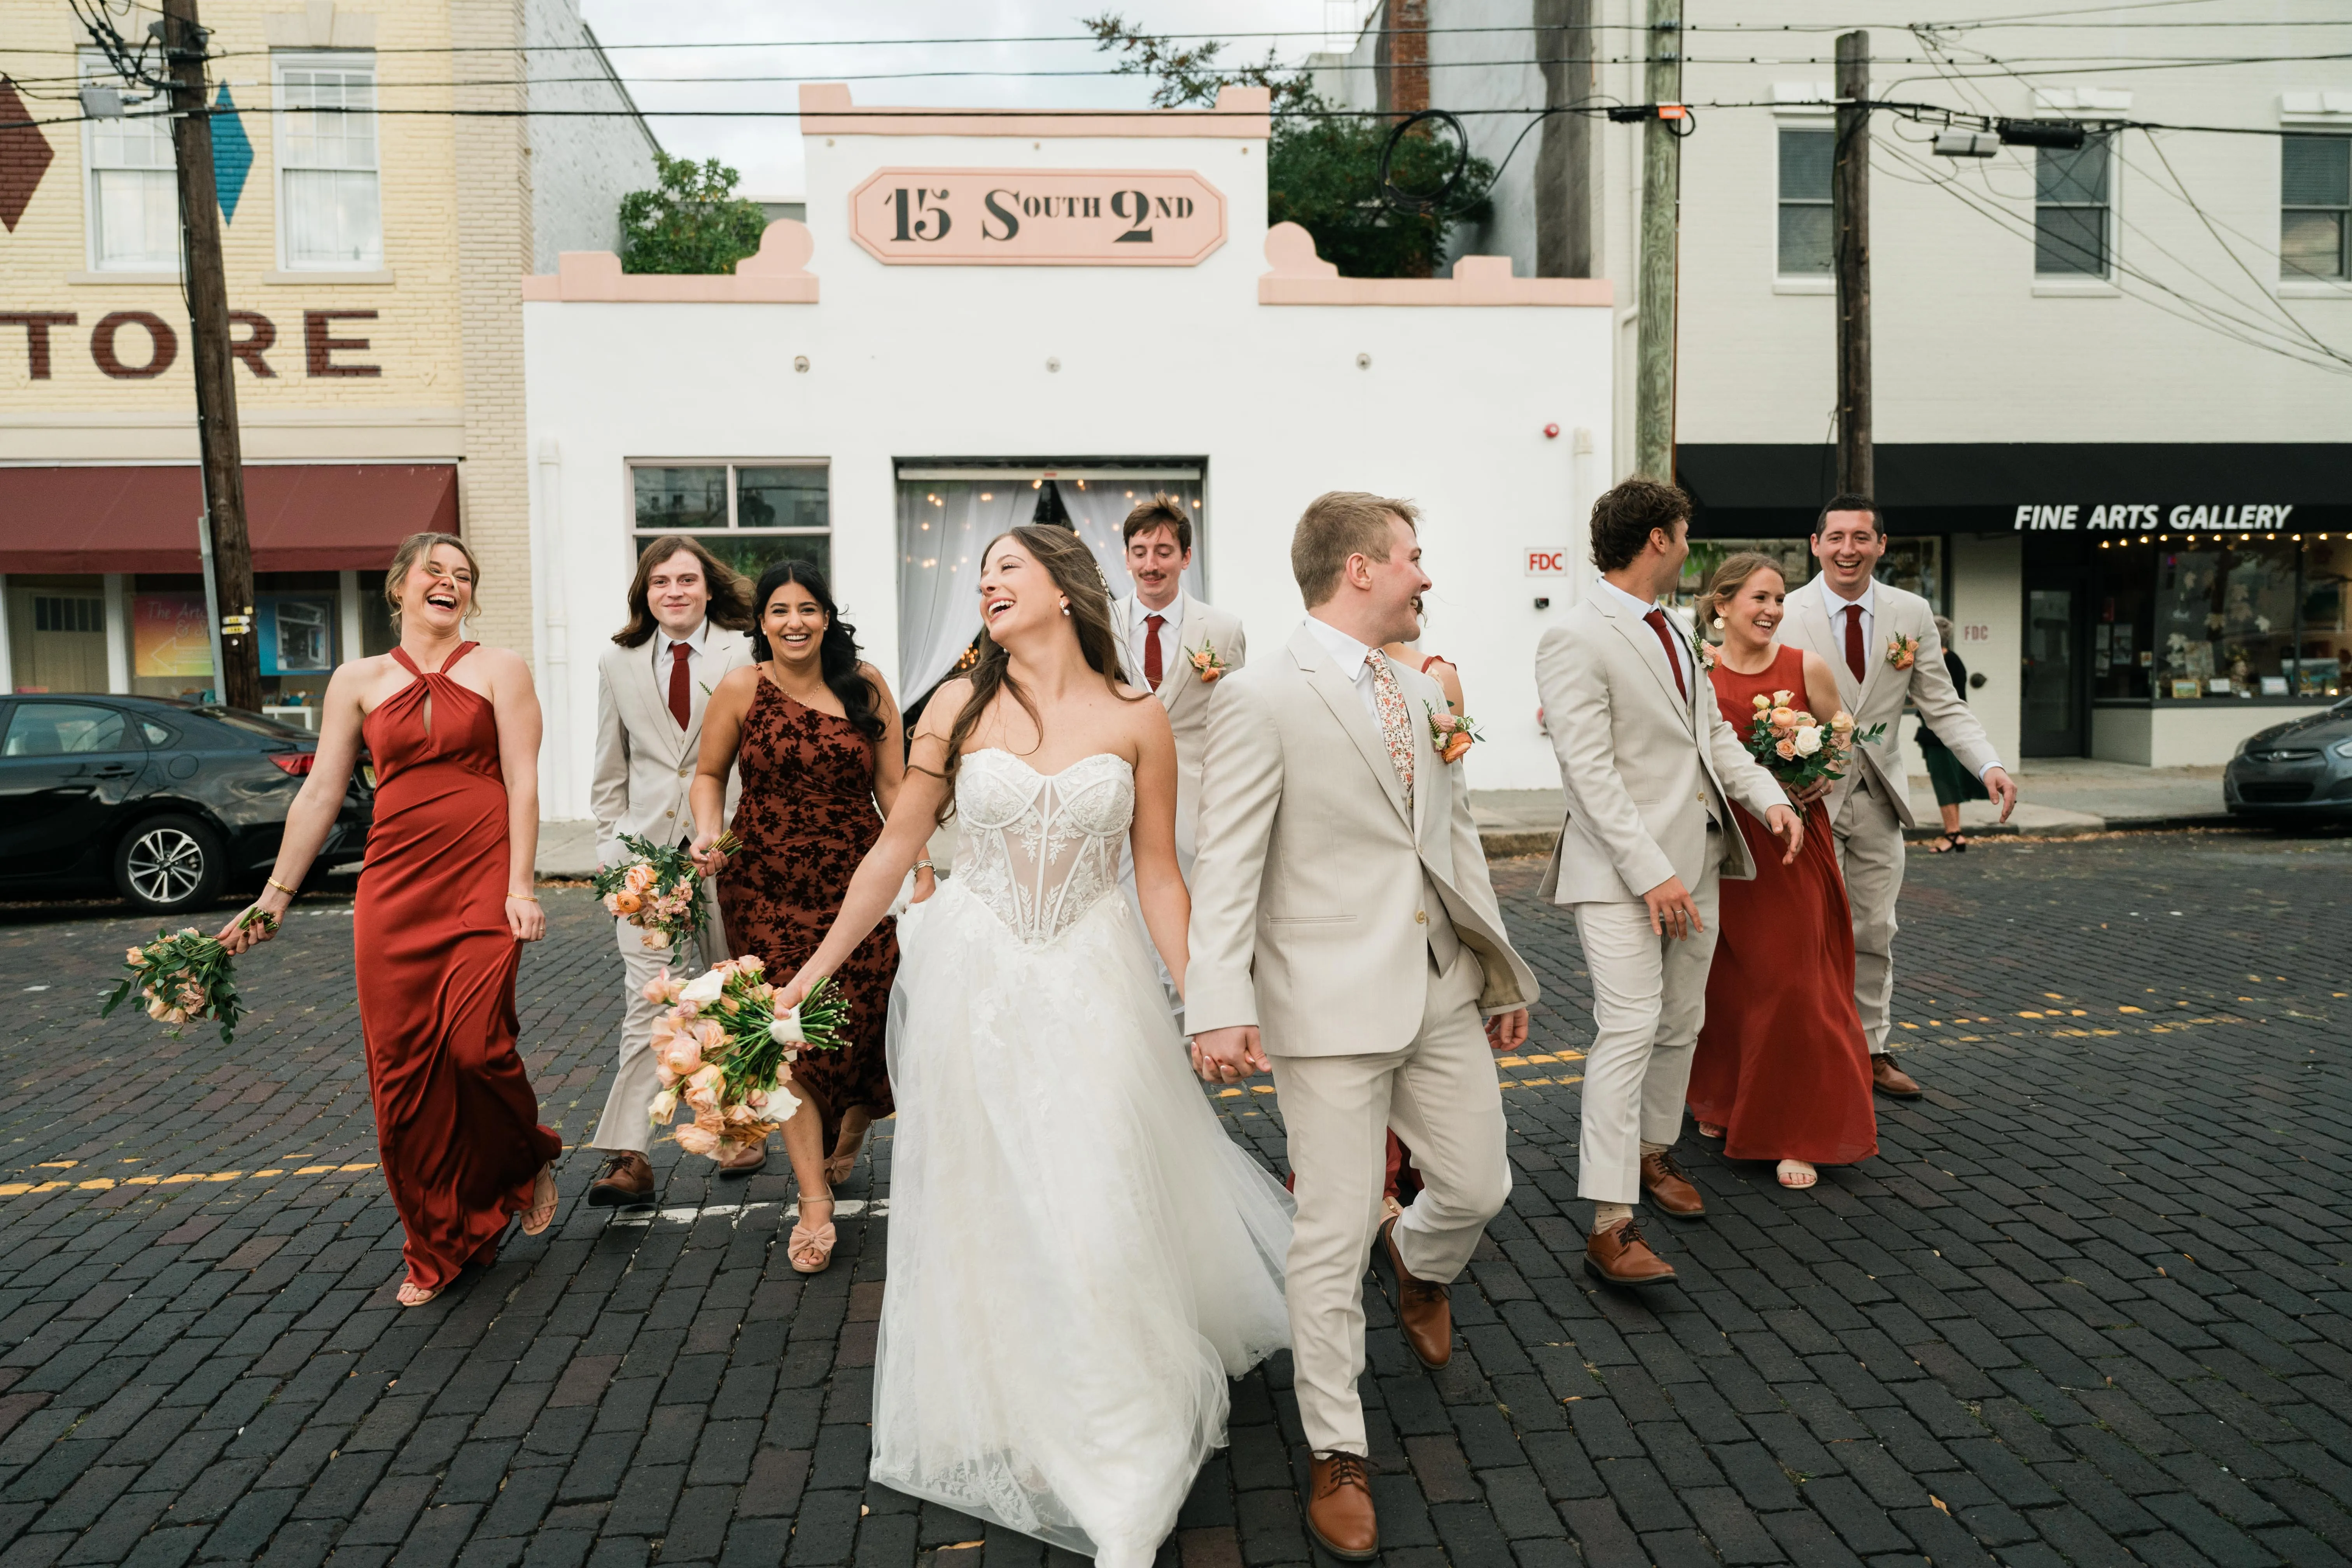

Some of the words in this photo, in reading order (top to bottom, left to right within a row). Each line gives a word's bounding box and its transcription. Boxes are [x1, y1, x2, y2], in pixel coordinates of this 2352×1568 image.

[884, 188, 952, 242] 15
[2014, 505, 2079, 530] FINE
[2086, 504, 2160, 530] ARTS
[2169, 504, 2293, 530] GALLERY
[1529, 552, 1562, 570] FDC
[147, 600, 171, 620] The
[1965, 626, 1988, 640] FDC
